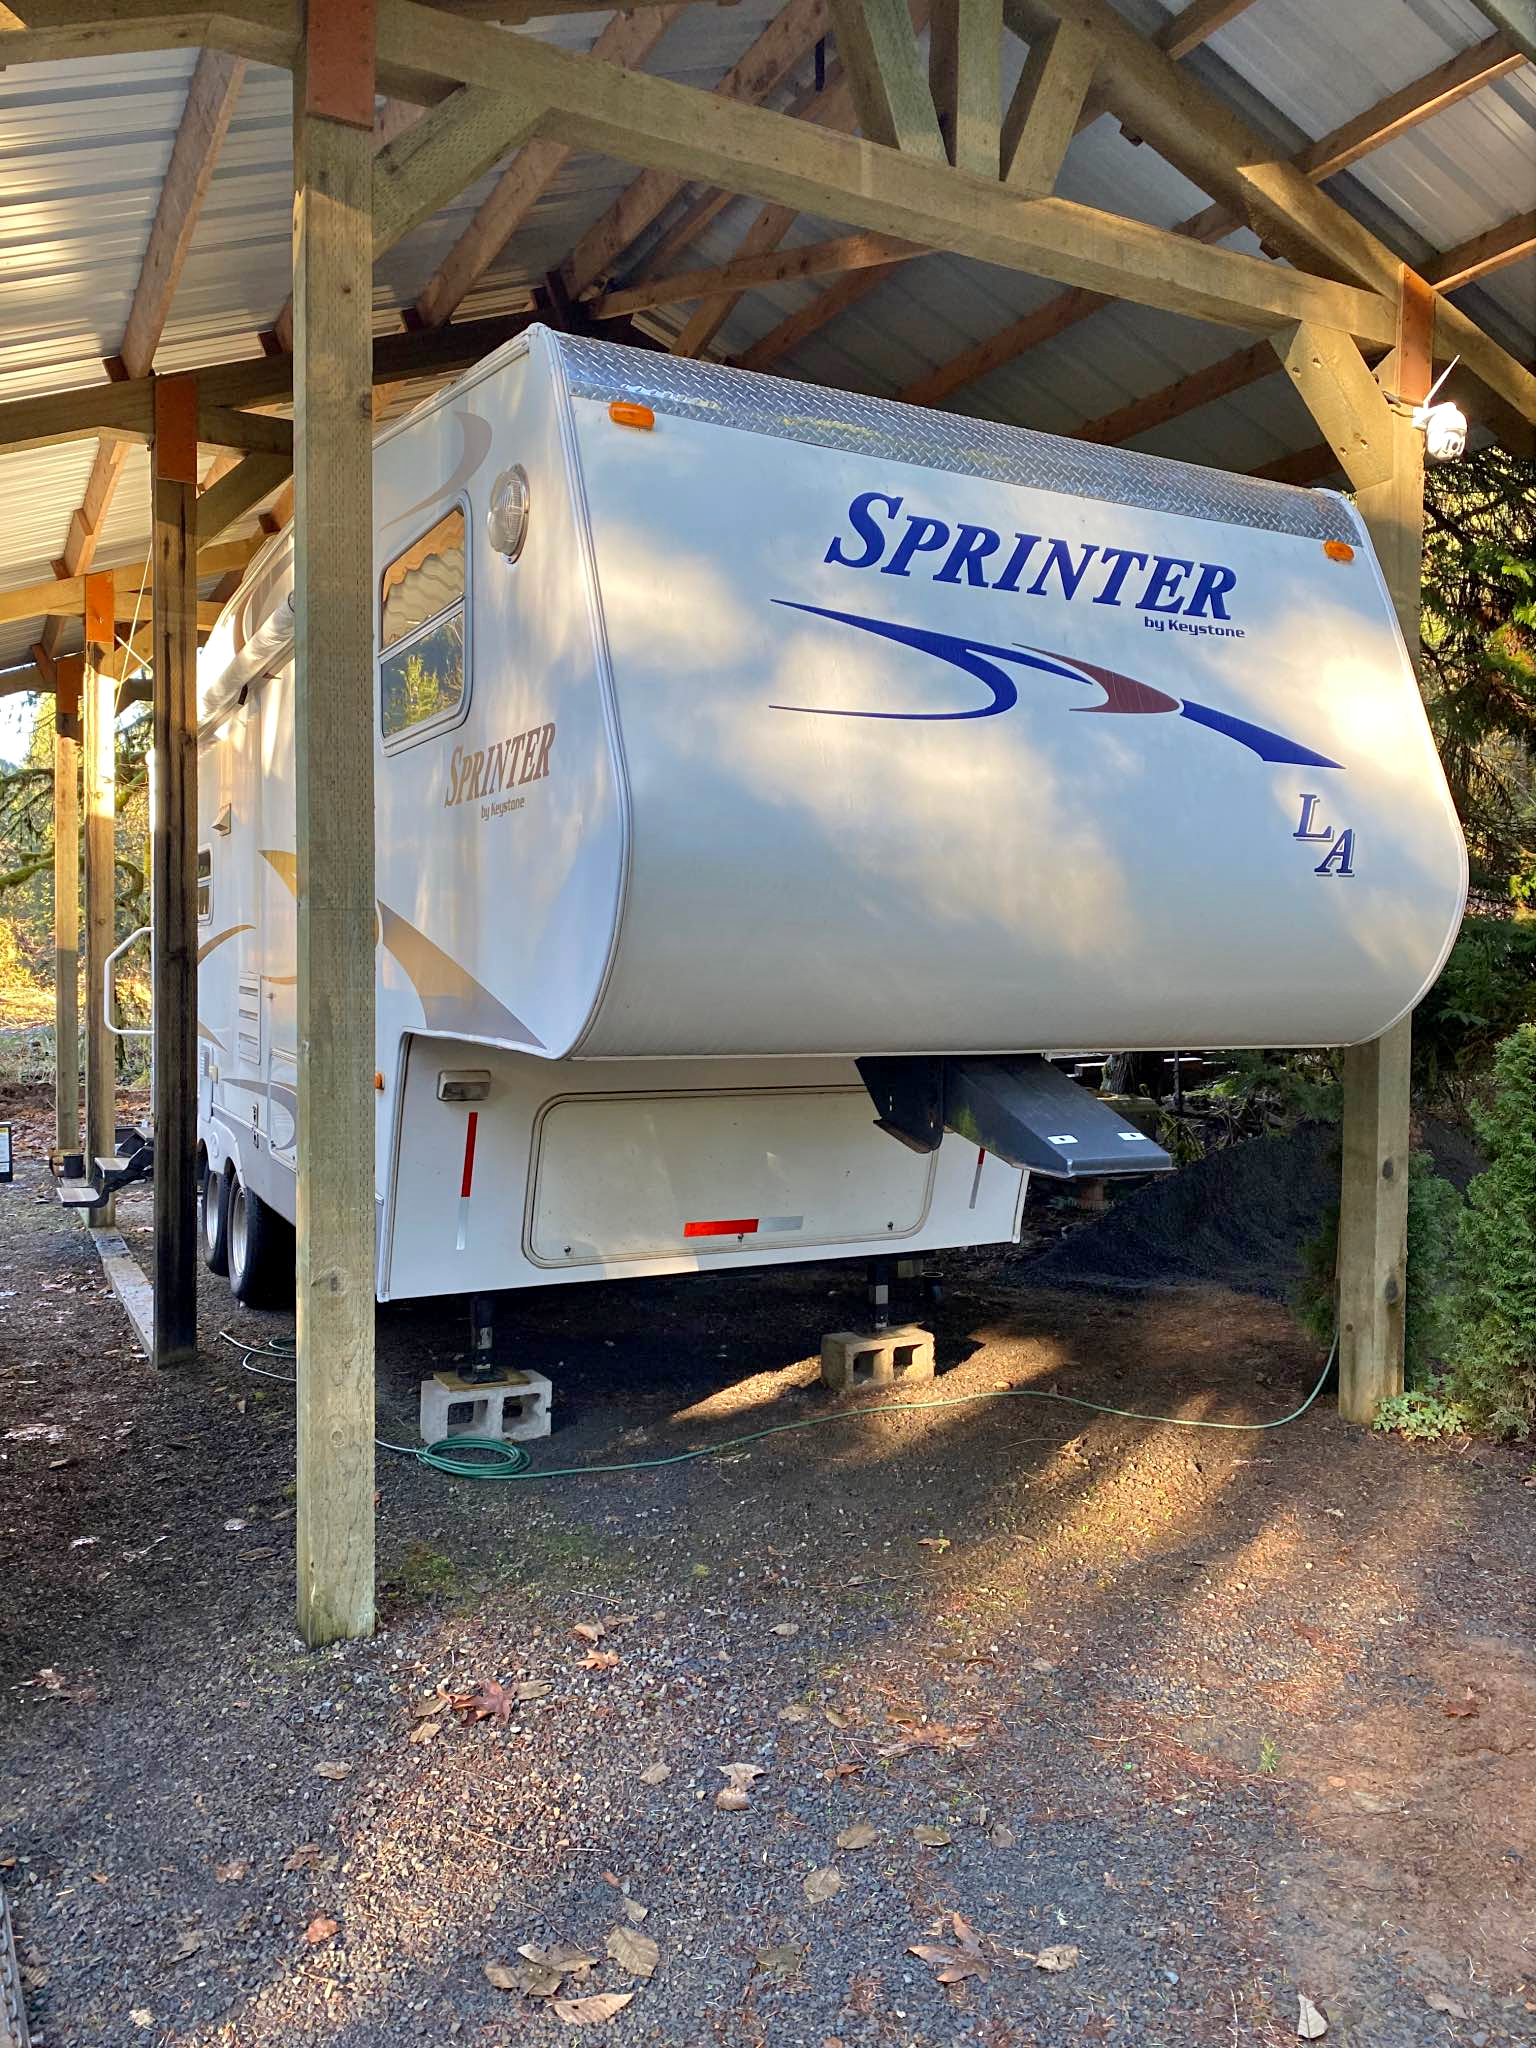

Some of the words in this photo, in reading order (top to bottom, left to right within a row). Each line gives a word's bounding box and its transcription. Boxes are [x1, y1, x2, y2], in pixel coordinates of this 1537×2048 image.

[824, 491, 1237, 620] SPRINTER
[1144, 616, 1164, 632] by
[1168, 619, 1246, 638] Keystone
[444, 722, 556, 808] SPRINTER
[480, 804, 491, 821] by
[490, 797, 525, 817] Keystone
